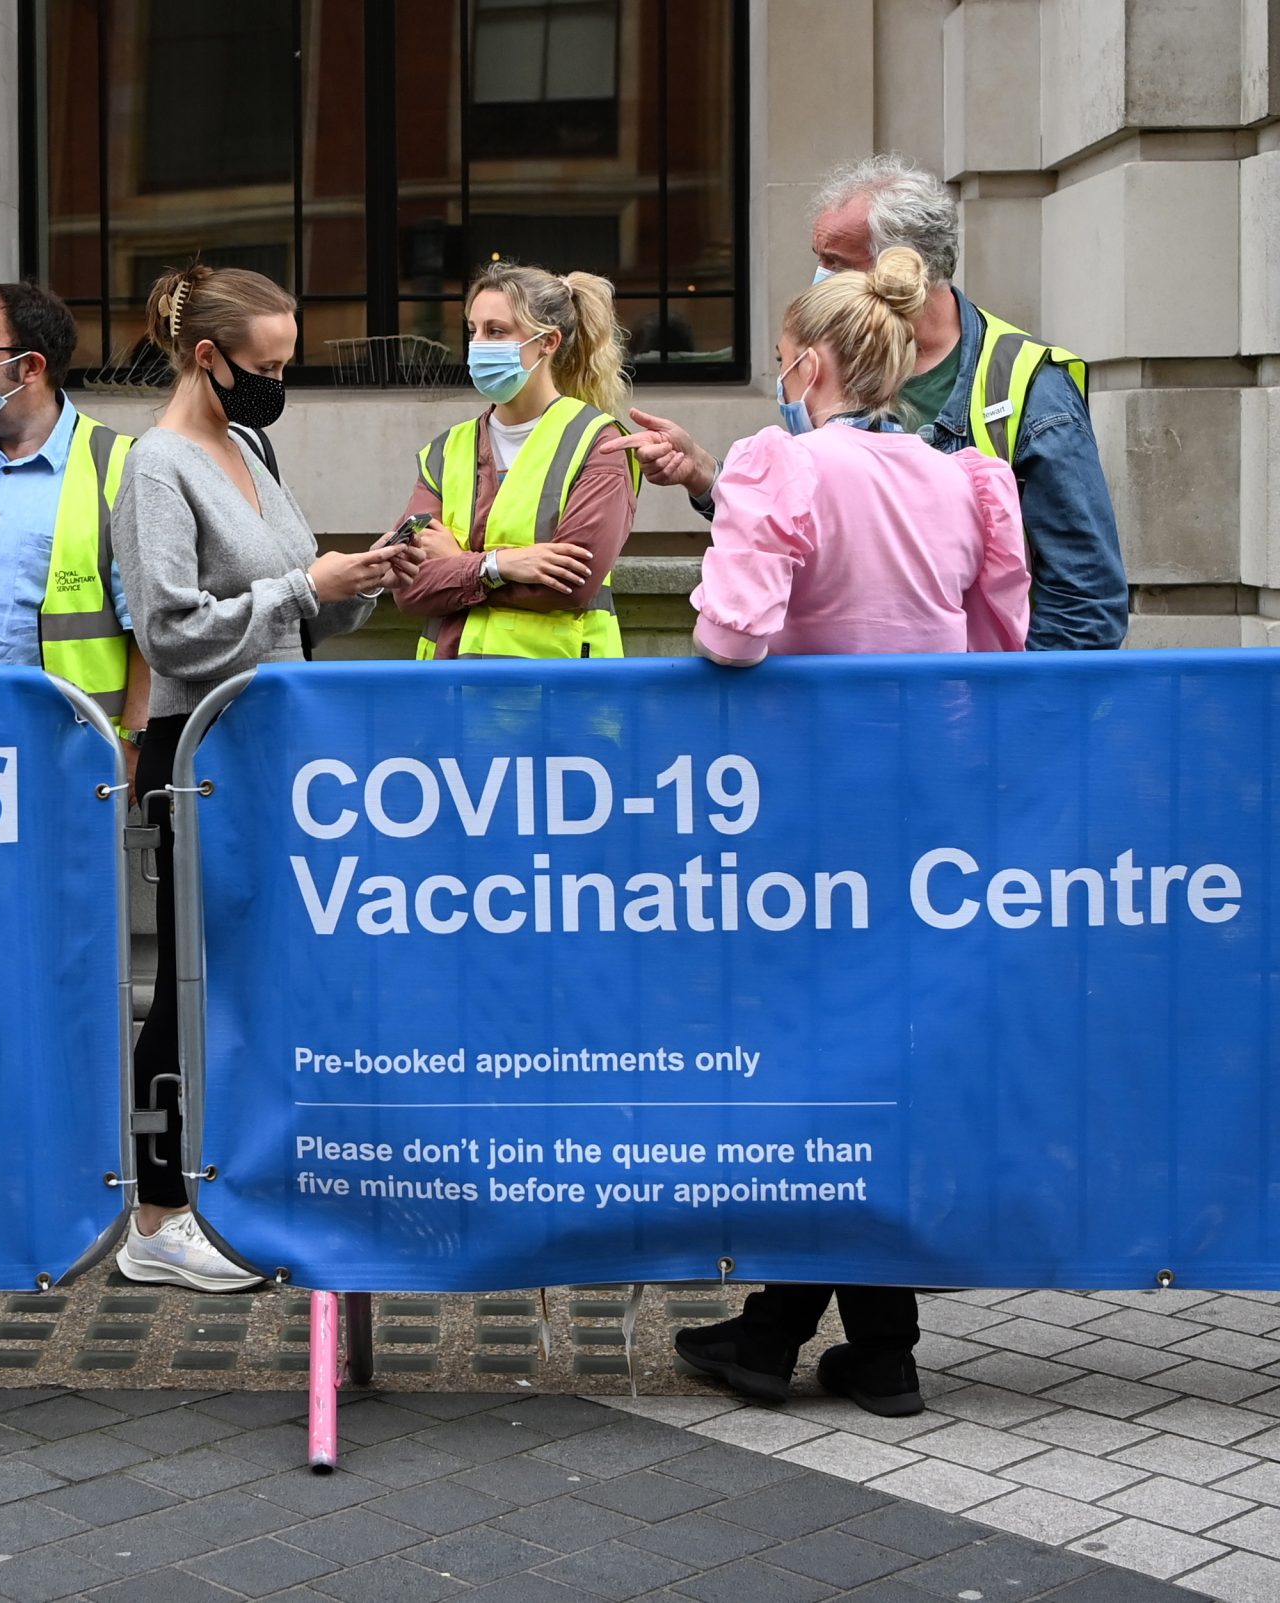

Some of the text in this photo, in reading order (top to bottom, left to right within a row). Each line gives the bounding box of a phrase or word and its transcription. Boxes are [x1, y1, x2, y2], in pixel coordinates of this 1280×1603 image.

[982, 406, 1006, 419] tewart
[55, 570, 79, 579] ROYAL
[55, 575, 96, 585] VOLUNTARY
[56, 584, 81, 592] SERVICE
[292, 754, 760, 840] COVID-19
[289, 847, 1242, 936] Vaccination Centre
[295, 1045, 760, 1079] Pre-booked appointments only
[296, 1136, 872, 1170] Please don’t join the queue more than
[297, 1172, 867, 1209] five minutes before your appointment
